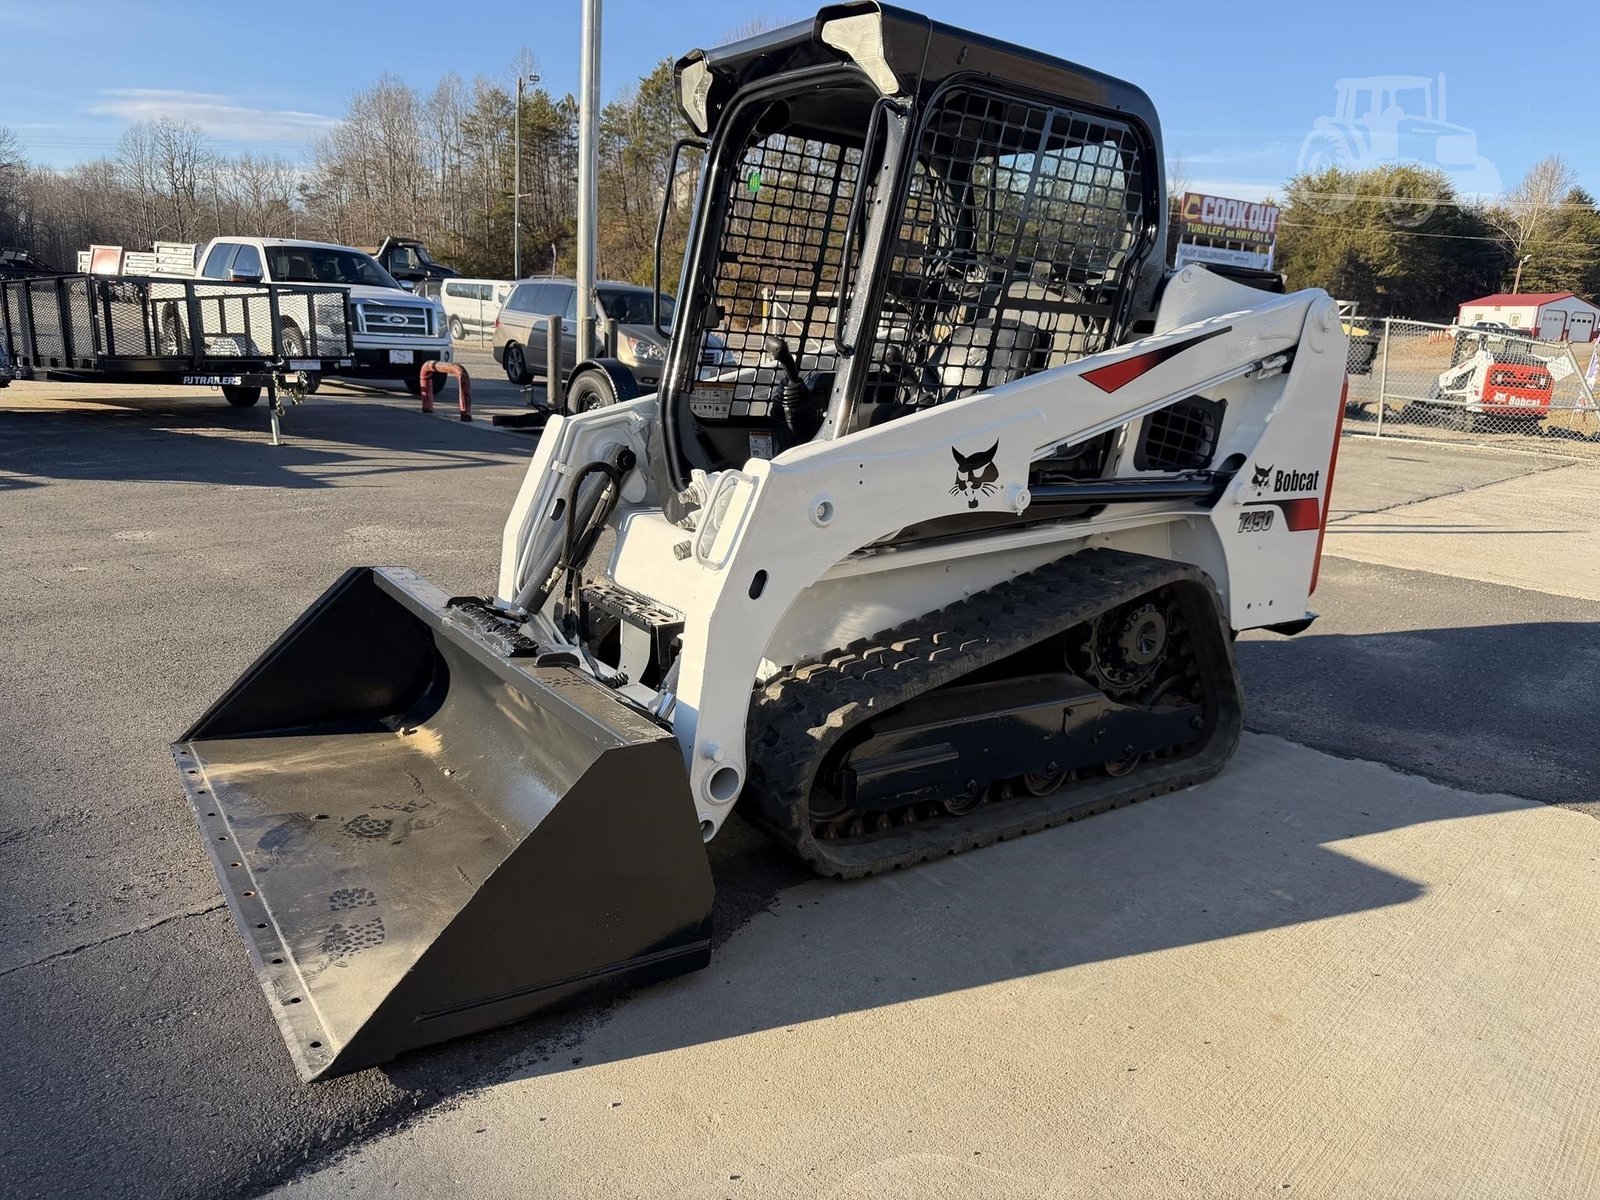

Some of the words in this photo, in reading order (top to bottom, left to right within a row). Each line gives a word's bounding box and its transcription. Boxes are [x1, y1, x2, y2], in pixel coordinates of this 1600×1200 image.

[1202, 196, 1248, 228] COOK
[1248, 205, 1279, 232] OUT
[1187, 223, 1207, 233] TURN
[1208, 225, 1225, 236] LEFT
[1226, 229, 1235, 238] on
[1236, 229, 1252, 240] HWY
[1252, 231, 1263, 242] 601
[194, 376, 242, 385] TRAILERS
[1509, 395, 1540, 407] Bobcat
[1273, 469, 1319, 492] Bobcat
[1238, 510, 1275, 533] T450
